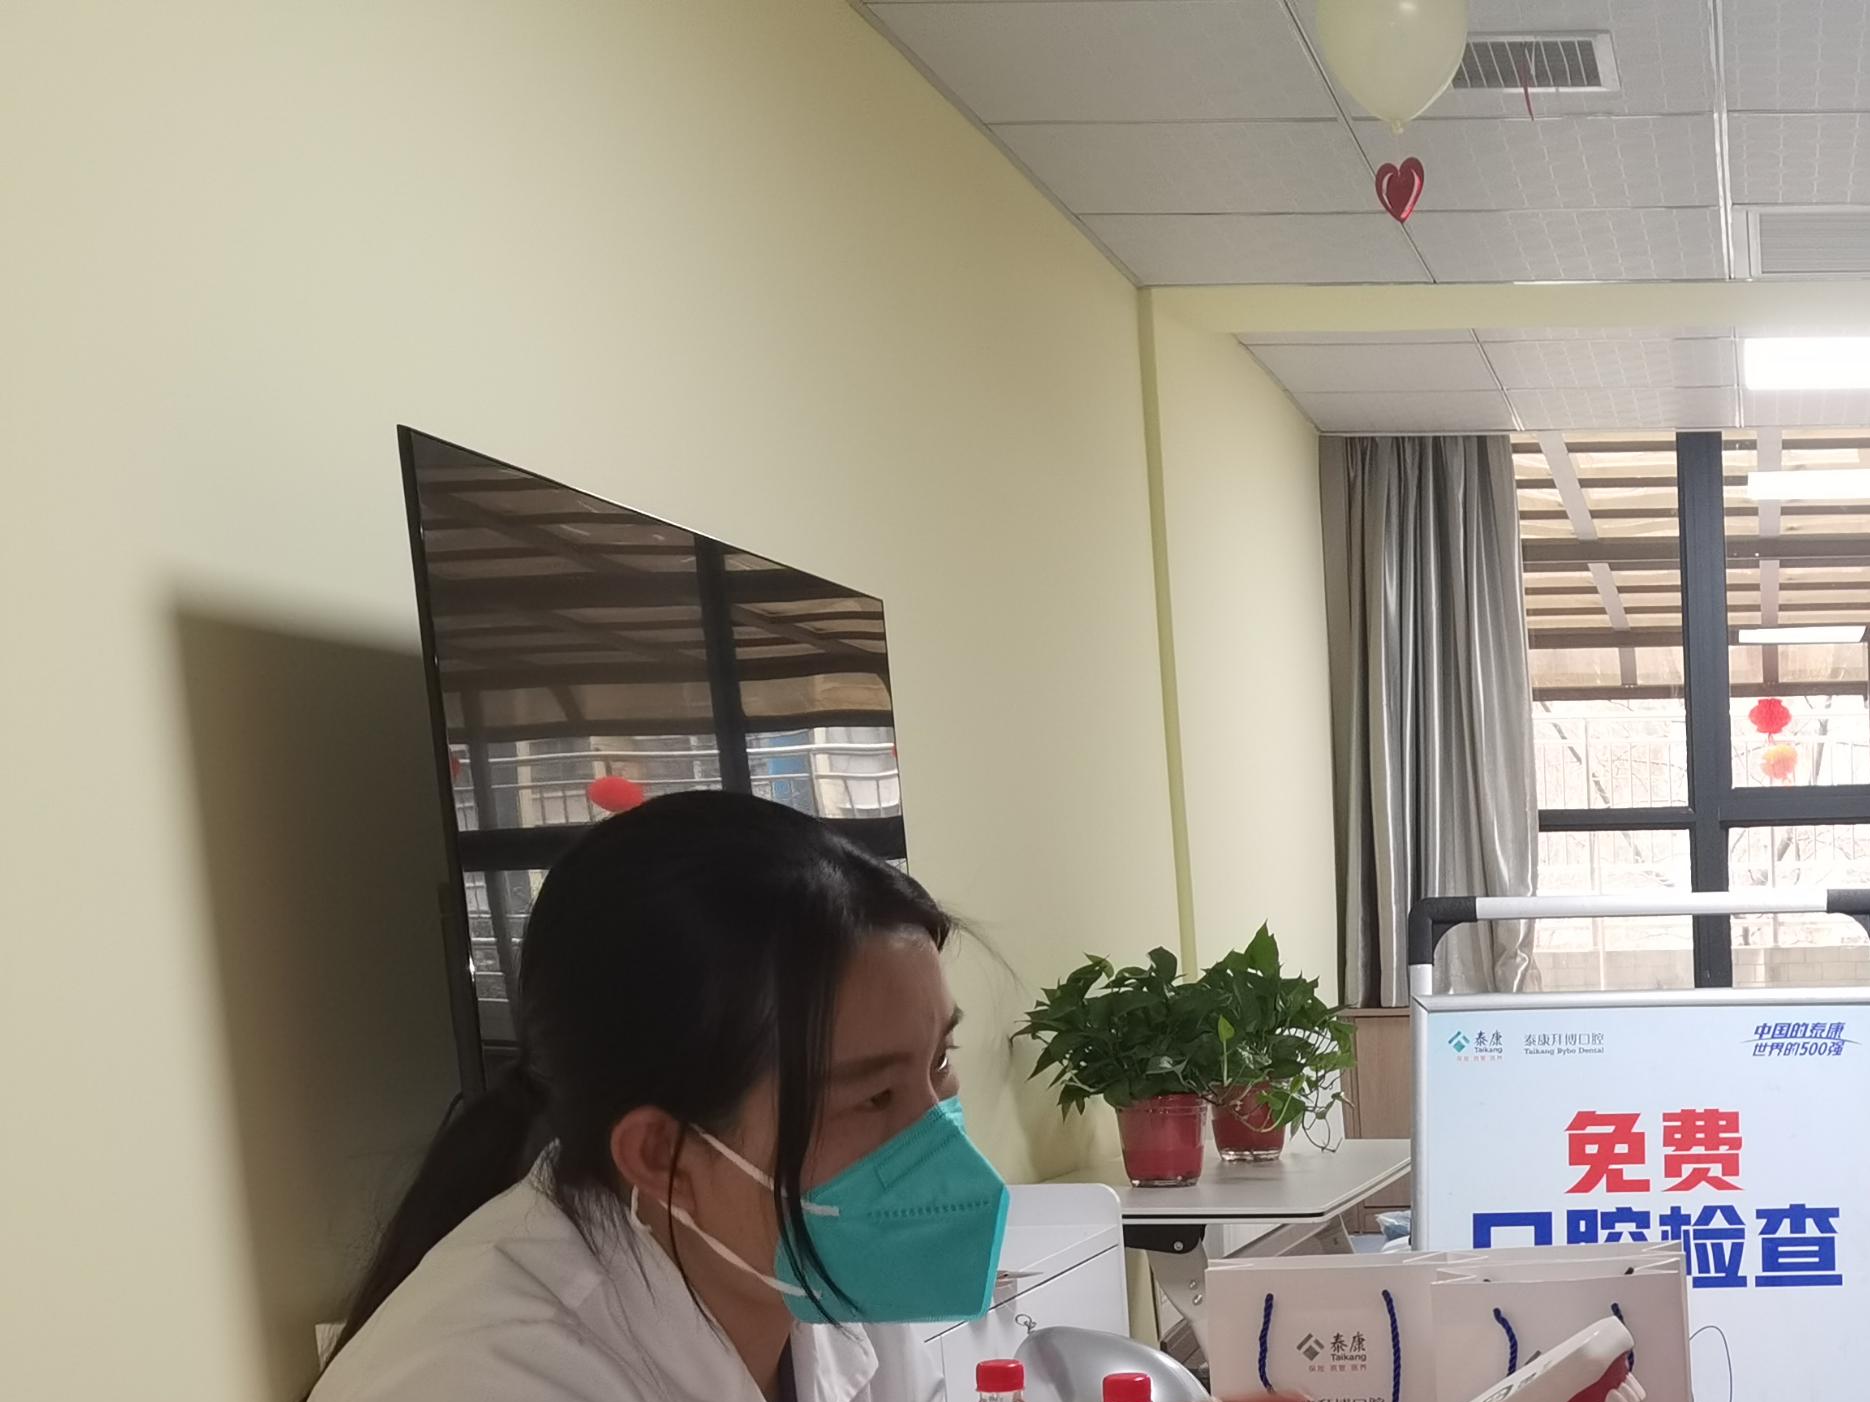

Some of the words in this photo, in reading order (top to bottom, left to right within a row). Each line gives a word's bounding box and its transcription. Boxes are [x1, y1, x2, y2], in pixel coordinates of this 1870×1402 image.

[1475, 1030, 1503, 1046] 泰康
[1753, 1040, 1844, 1056] 世界的500强
[1564, 1108, 1744, 1194] 免费
[1330, 1331, 1366, 1352] 泰康
[1330, 1353, 1367, 1361] Taikang
